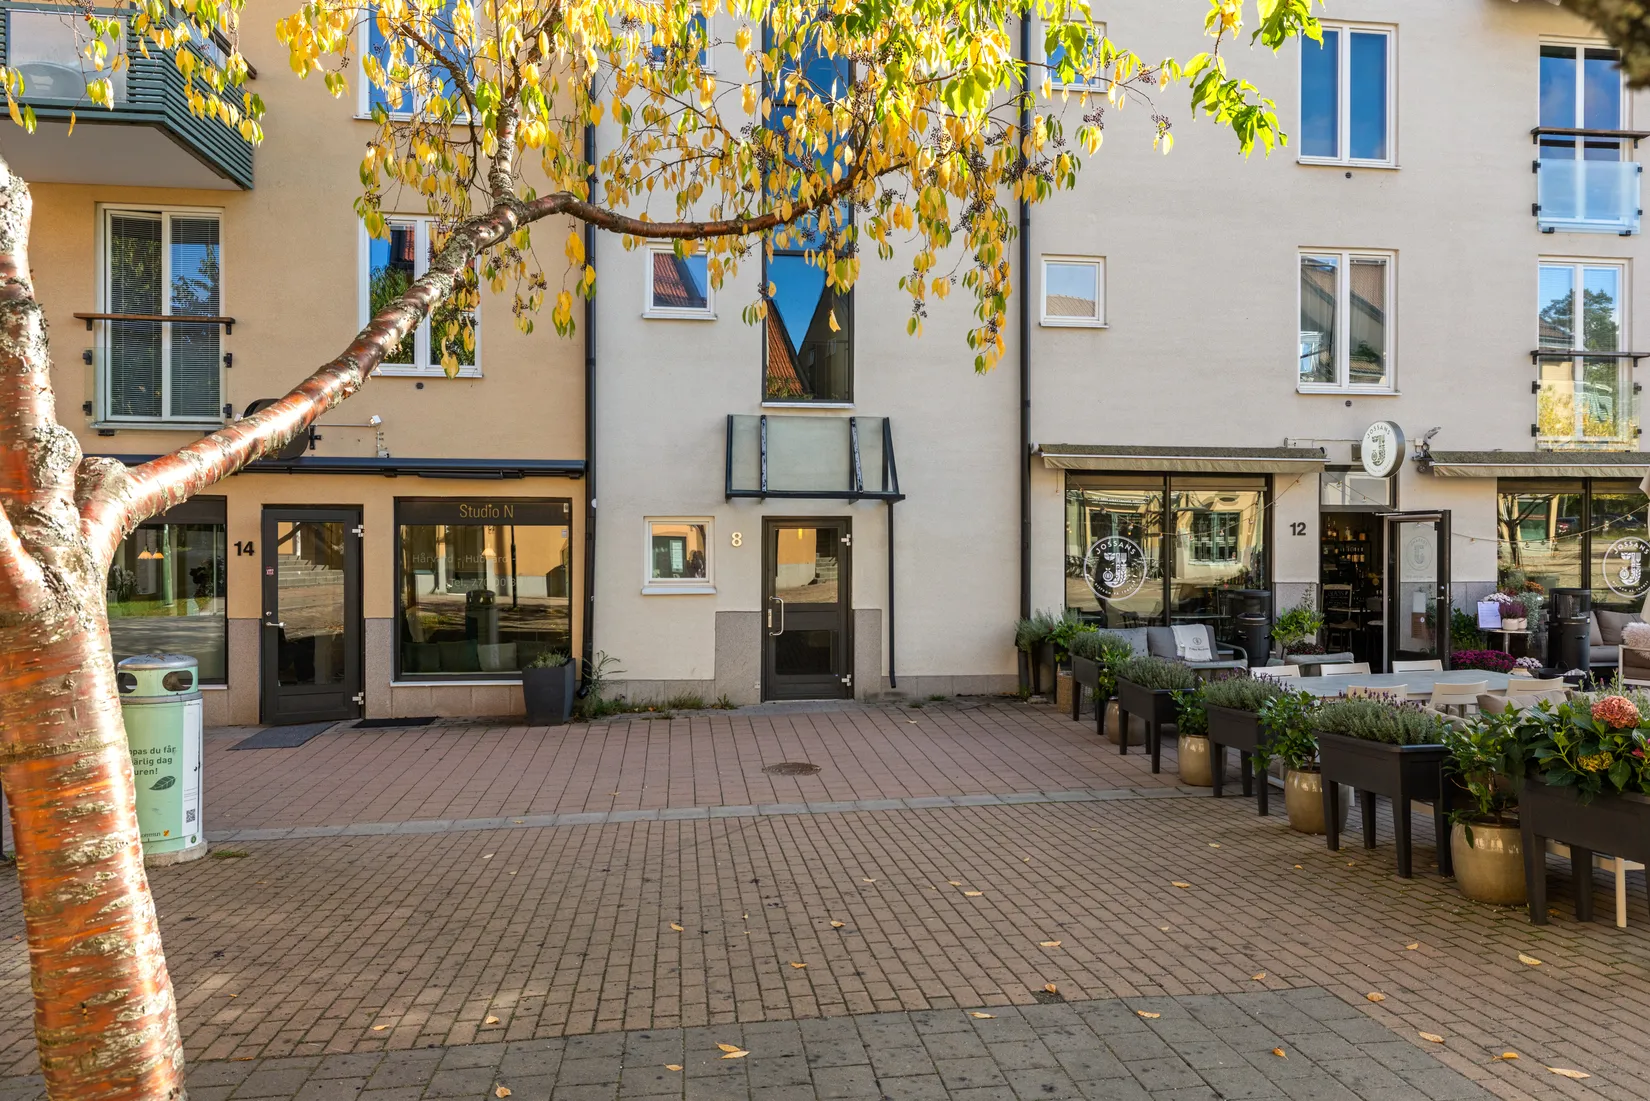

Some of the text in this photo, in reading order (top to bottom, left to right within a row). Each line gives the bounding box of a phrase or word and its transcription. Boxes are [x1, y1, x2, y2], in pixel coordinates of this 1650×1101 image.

[1366, 424, 1391, 439] JOSSANS
[459, 503, 514, 518] Studio N
[1289, 522, 1307, 536] 12
[731, 531, 743, 548] 8
[233, 541, 255, 557] 14
[1095, 540, 1136, 555] JOSSANS
[1613, 540, 1650, 555] JOSSANS
[412, 552, 454, 563] Hårvd
[163, 744, 177, 753] får
[132, 757, 173, 766] ärlig dag
